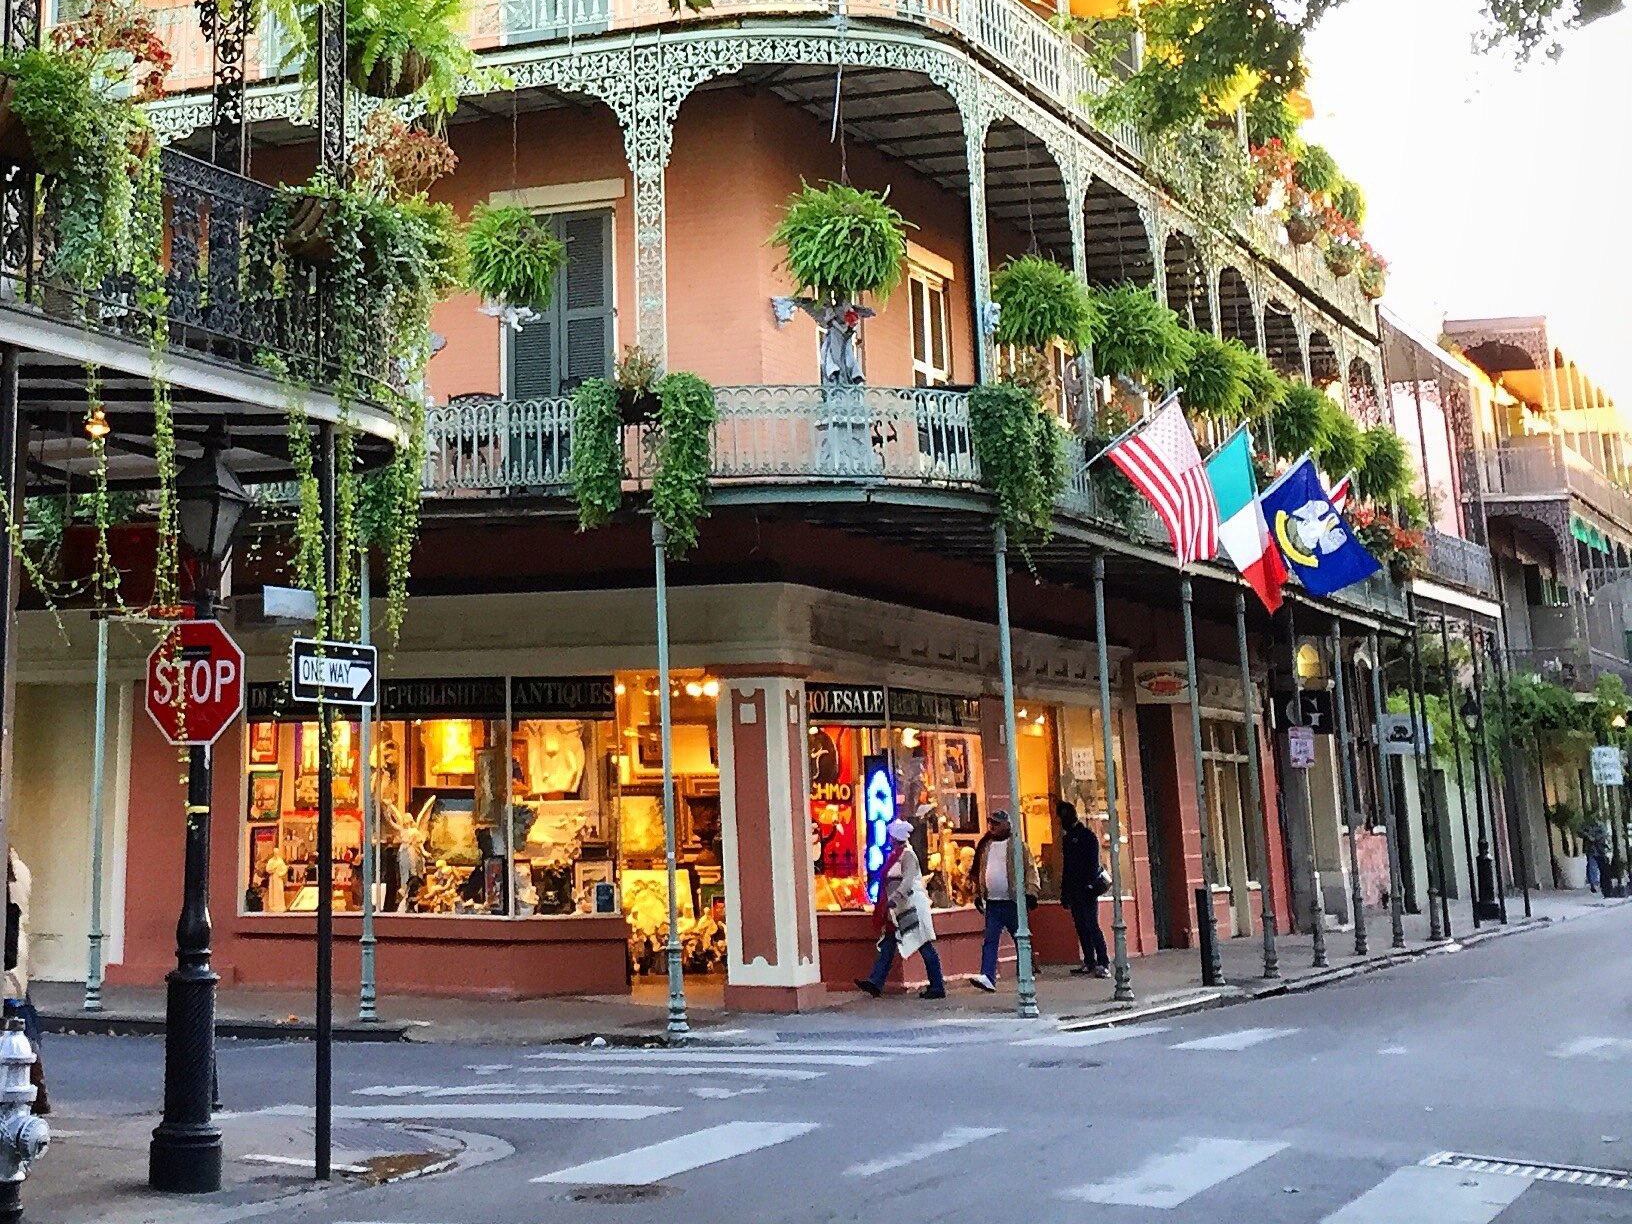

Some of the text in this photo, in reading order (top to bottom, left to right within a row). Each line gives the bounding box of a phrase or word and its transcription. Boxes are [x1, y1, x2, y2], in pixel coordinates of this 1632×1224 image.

[153, 659, 236, 705] STOP
[302, 659, 351, 685] ONE WAY
[397, 681, 505, 706] PUBLISHERS
[514, 682, 614, 708] ANTIQUES
